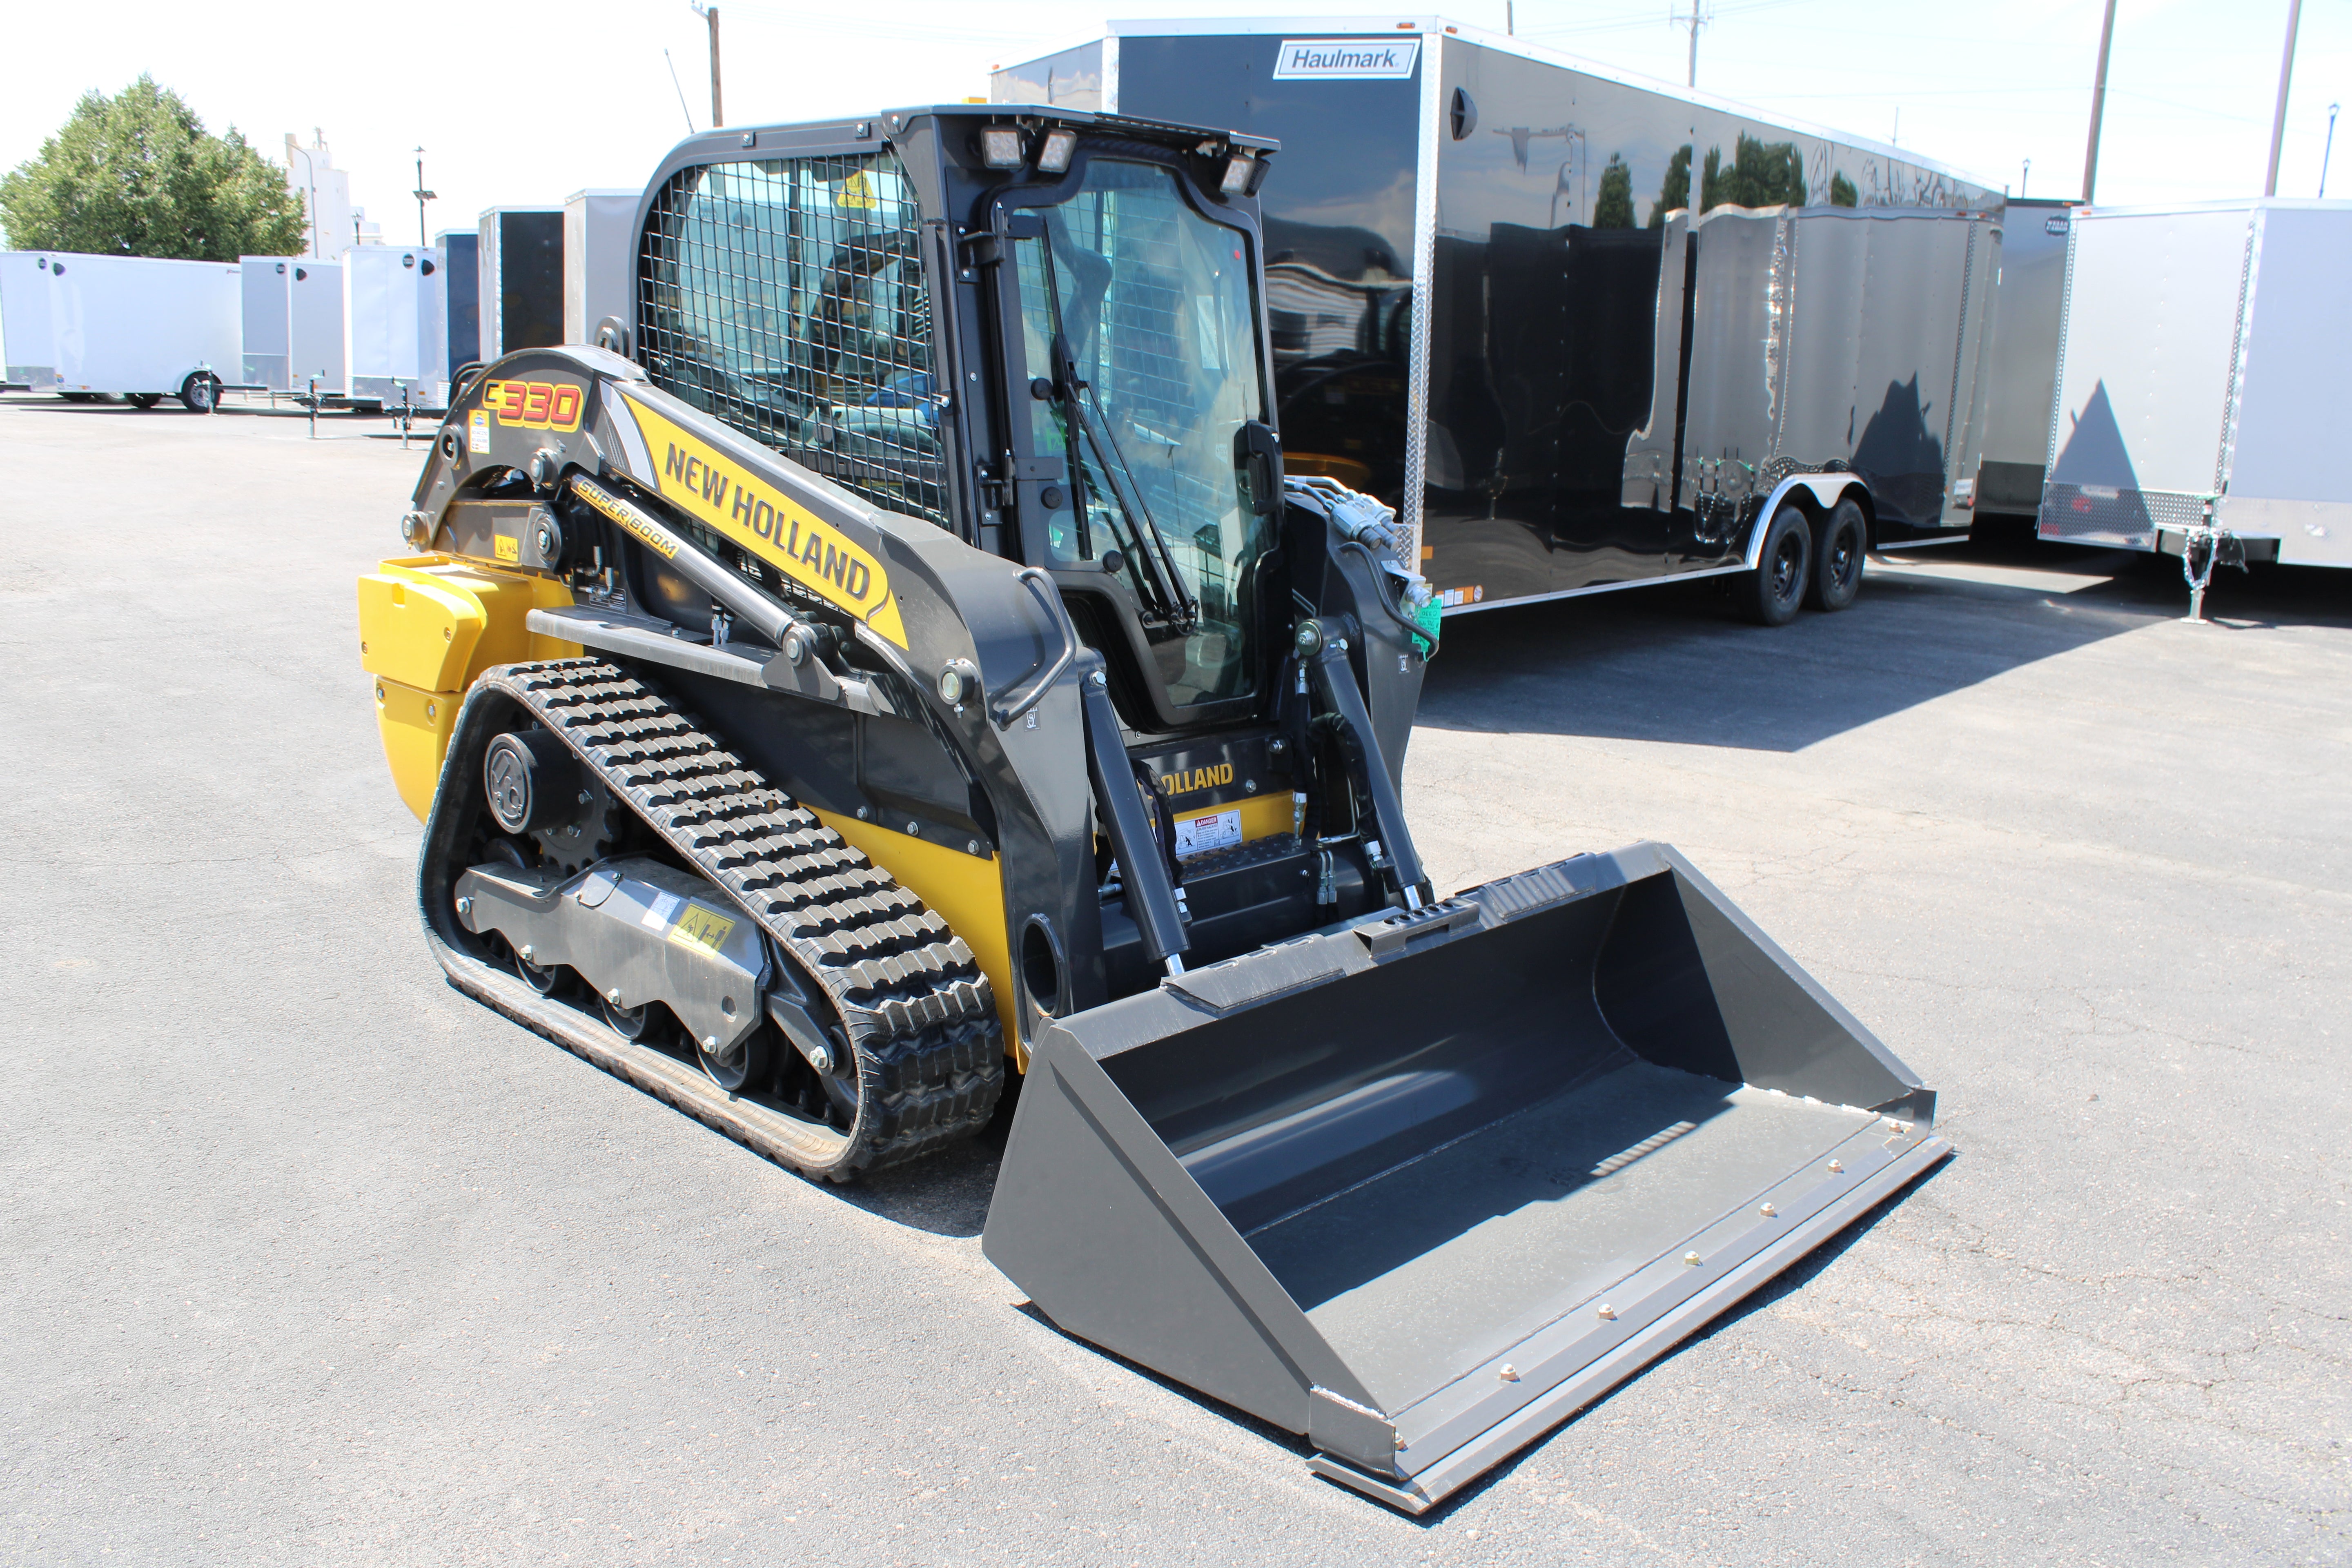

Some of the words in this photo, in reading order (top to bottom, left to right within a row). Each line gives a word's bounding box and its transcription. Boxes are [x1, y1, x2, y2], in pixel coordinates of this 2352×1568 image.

[1291, 49, 1397, 69] Haulmark
[483, 381, 582, 428] C330
[665, 441, 729, 510] NEW
[731, 484, 871, 601] HOLLAND
[1148, 762, 1234, 800] OLLAND
[1200, 817, 1217, 825] DANGER
